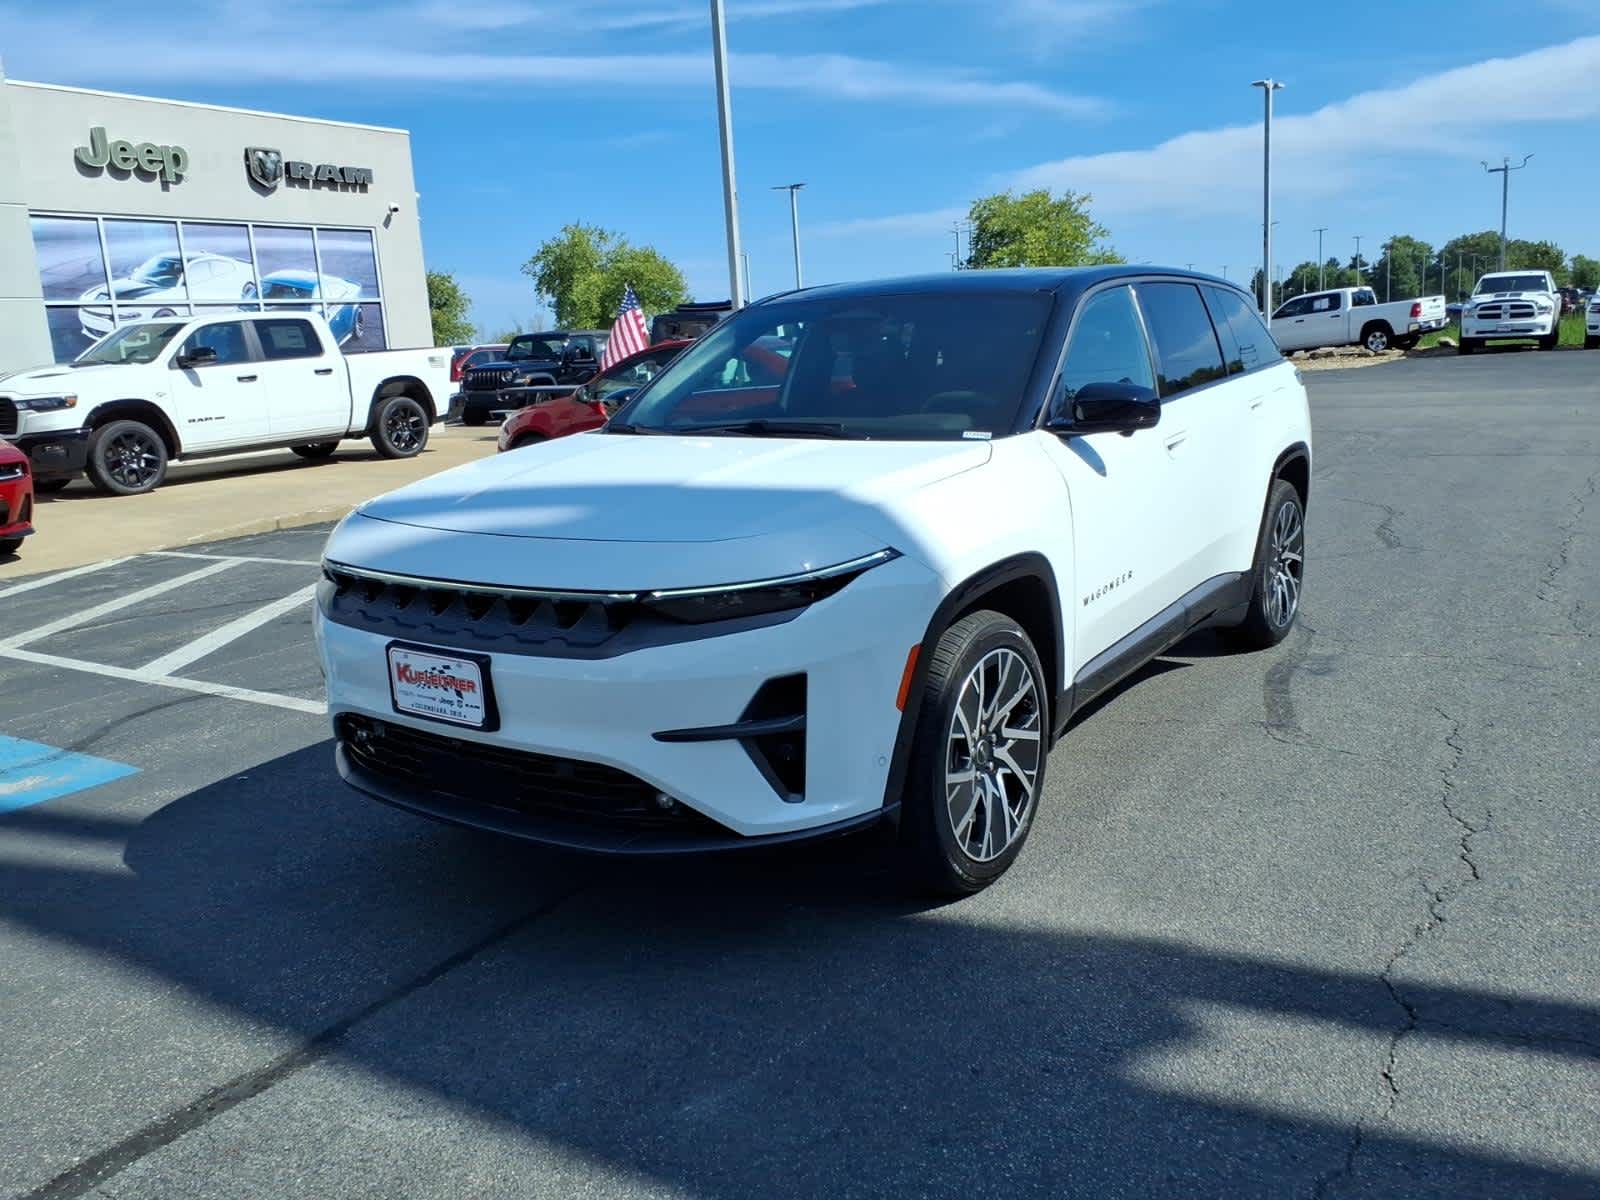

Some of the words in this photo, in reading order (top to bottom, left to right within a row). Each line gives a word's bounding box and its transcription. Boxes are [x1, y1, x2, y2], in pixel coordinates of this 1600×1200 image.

[74, 126, 189, 184] Jeep
[286, 160, 374, 185] RAM
[1083, 570, 1133, 607] WAGONEER
